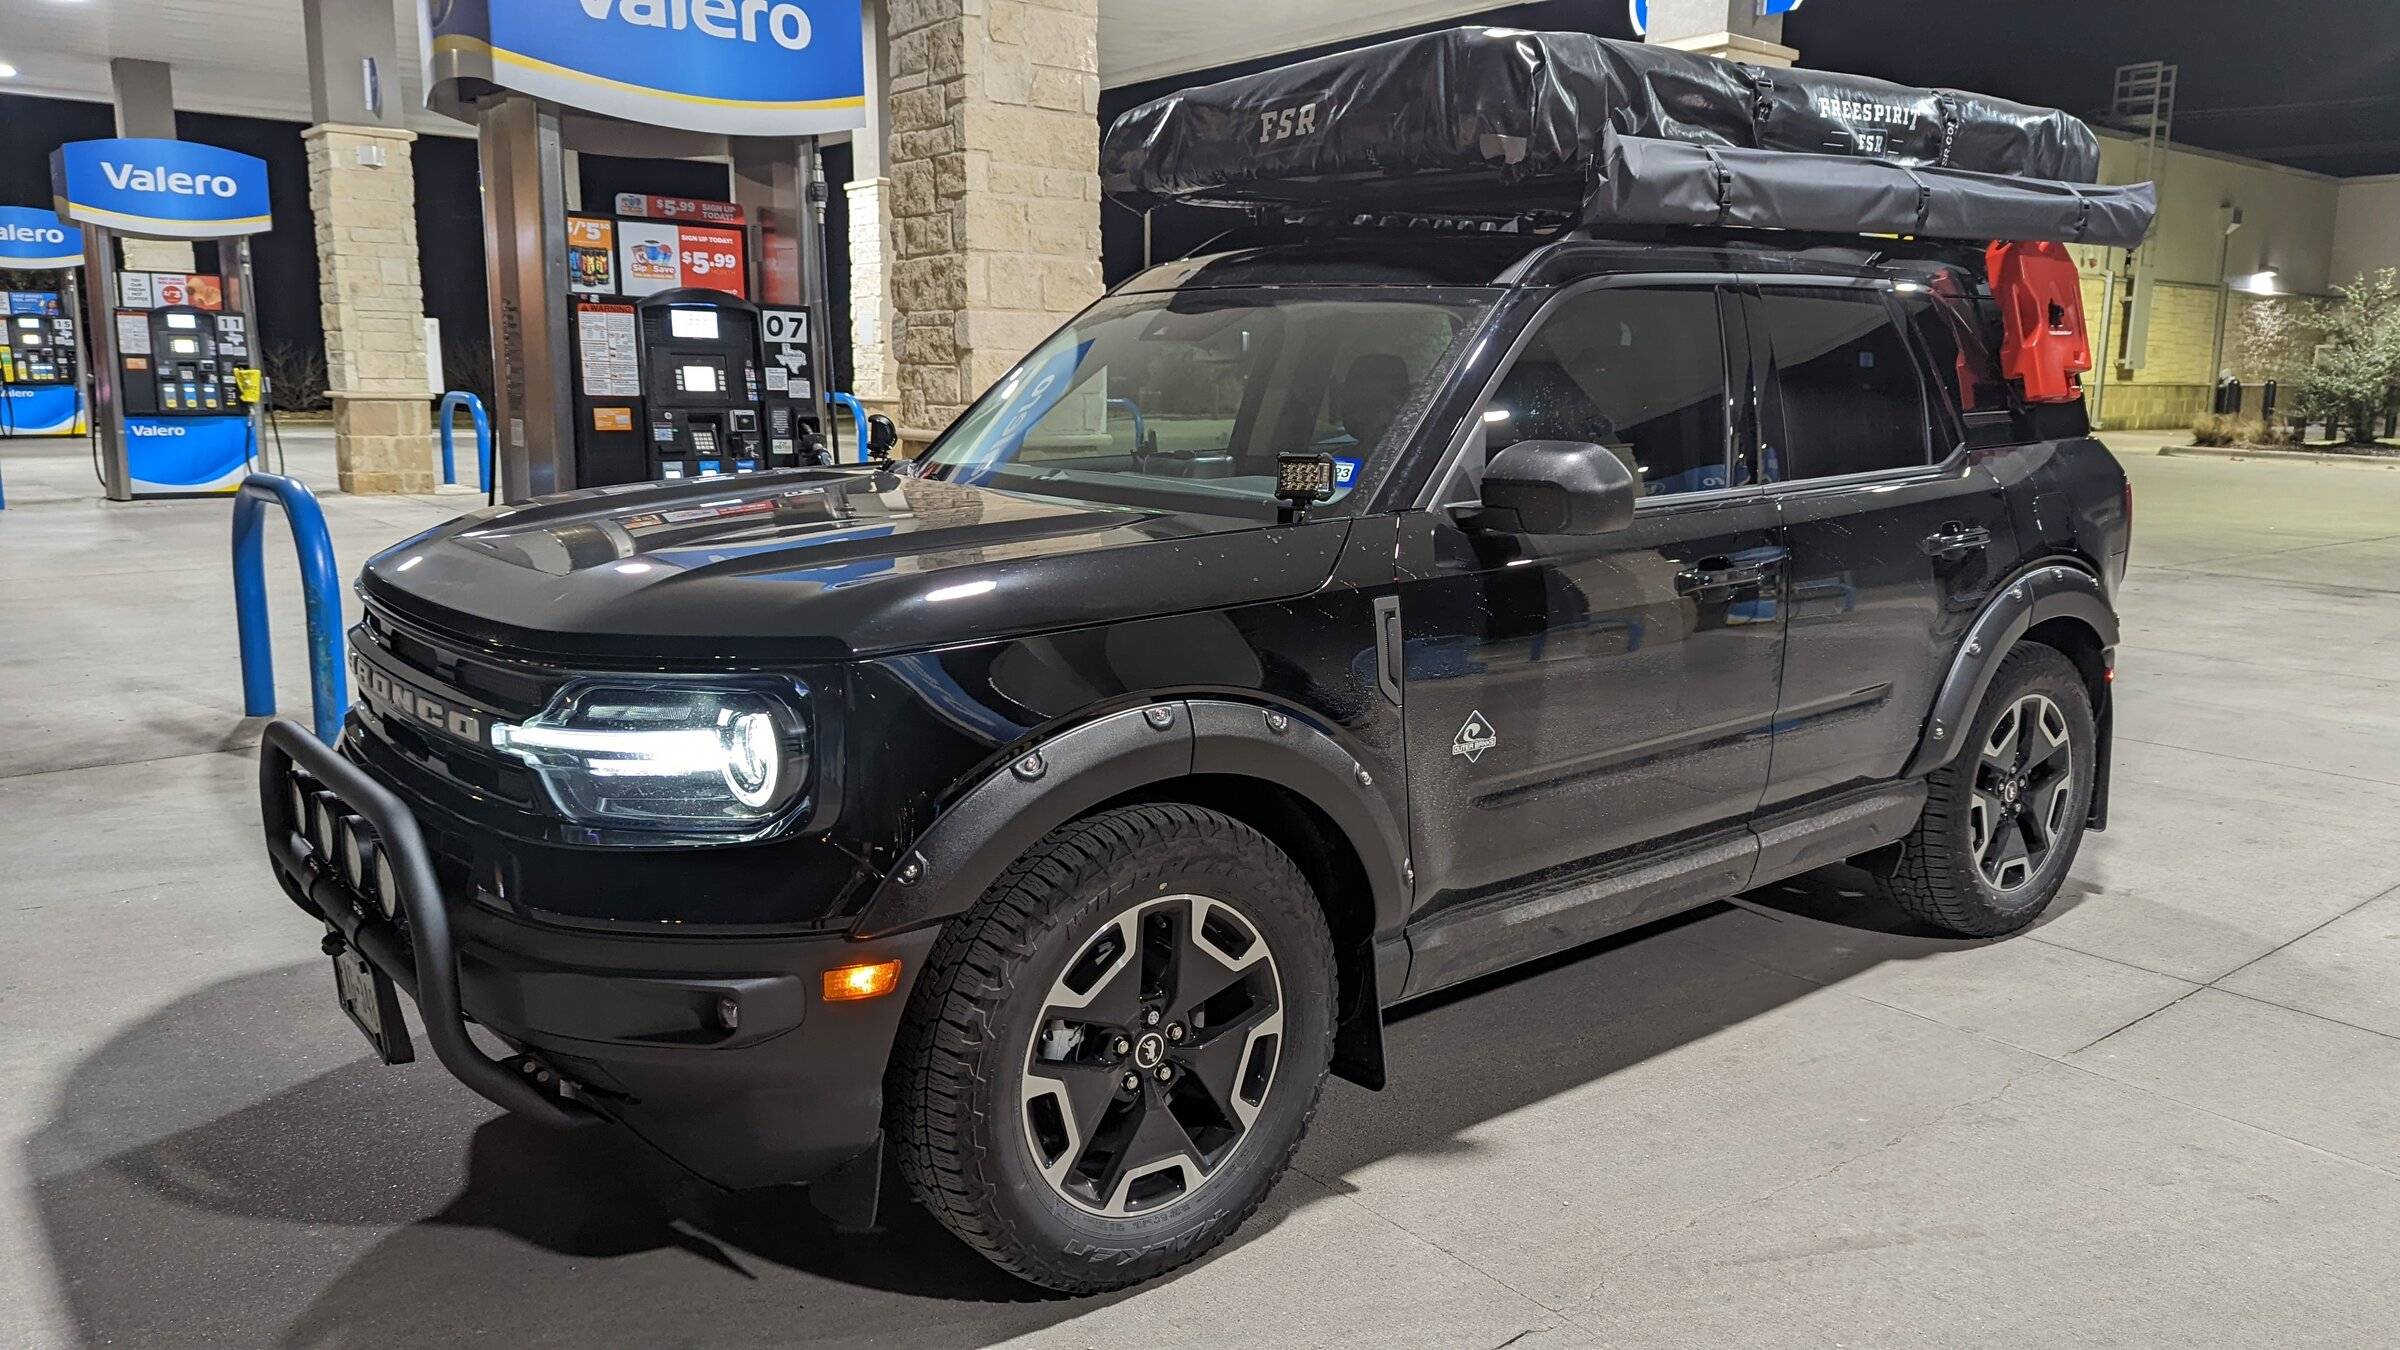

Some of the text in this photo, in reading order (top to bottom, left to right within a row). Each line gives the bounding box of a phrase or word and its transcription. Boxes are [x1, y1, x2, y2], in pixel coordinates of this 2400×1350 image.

[1818, 97, 1920, 130] FREESPIRIT
[1260, 103, 1316, 143] FSR
[1858, 134, 1883, 152] FSR
[101, 161, 237, 198] Valero
[656, 199, 696, 216] $5.99
[702, 203, 736, 213] SIGN UP
[702, 211, 735, 221] TODAY!
[0, 223, 65, 243] alero
[681, 234, 698, 242] SIGN
[699, 235, 708, 243] UP
[632, 263, 647, 273] Sip
[653, 265, 675, 274] Save
[681, 251, 737, 275] $5.99
[591, 304, 632, 313] WARNING
[222, 318, 240, 329] 11
[766, 315, 804, 339] 07
[131, 423, 186, 438] Valero
